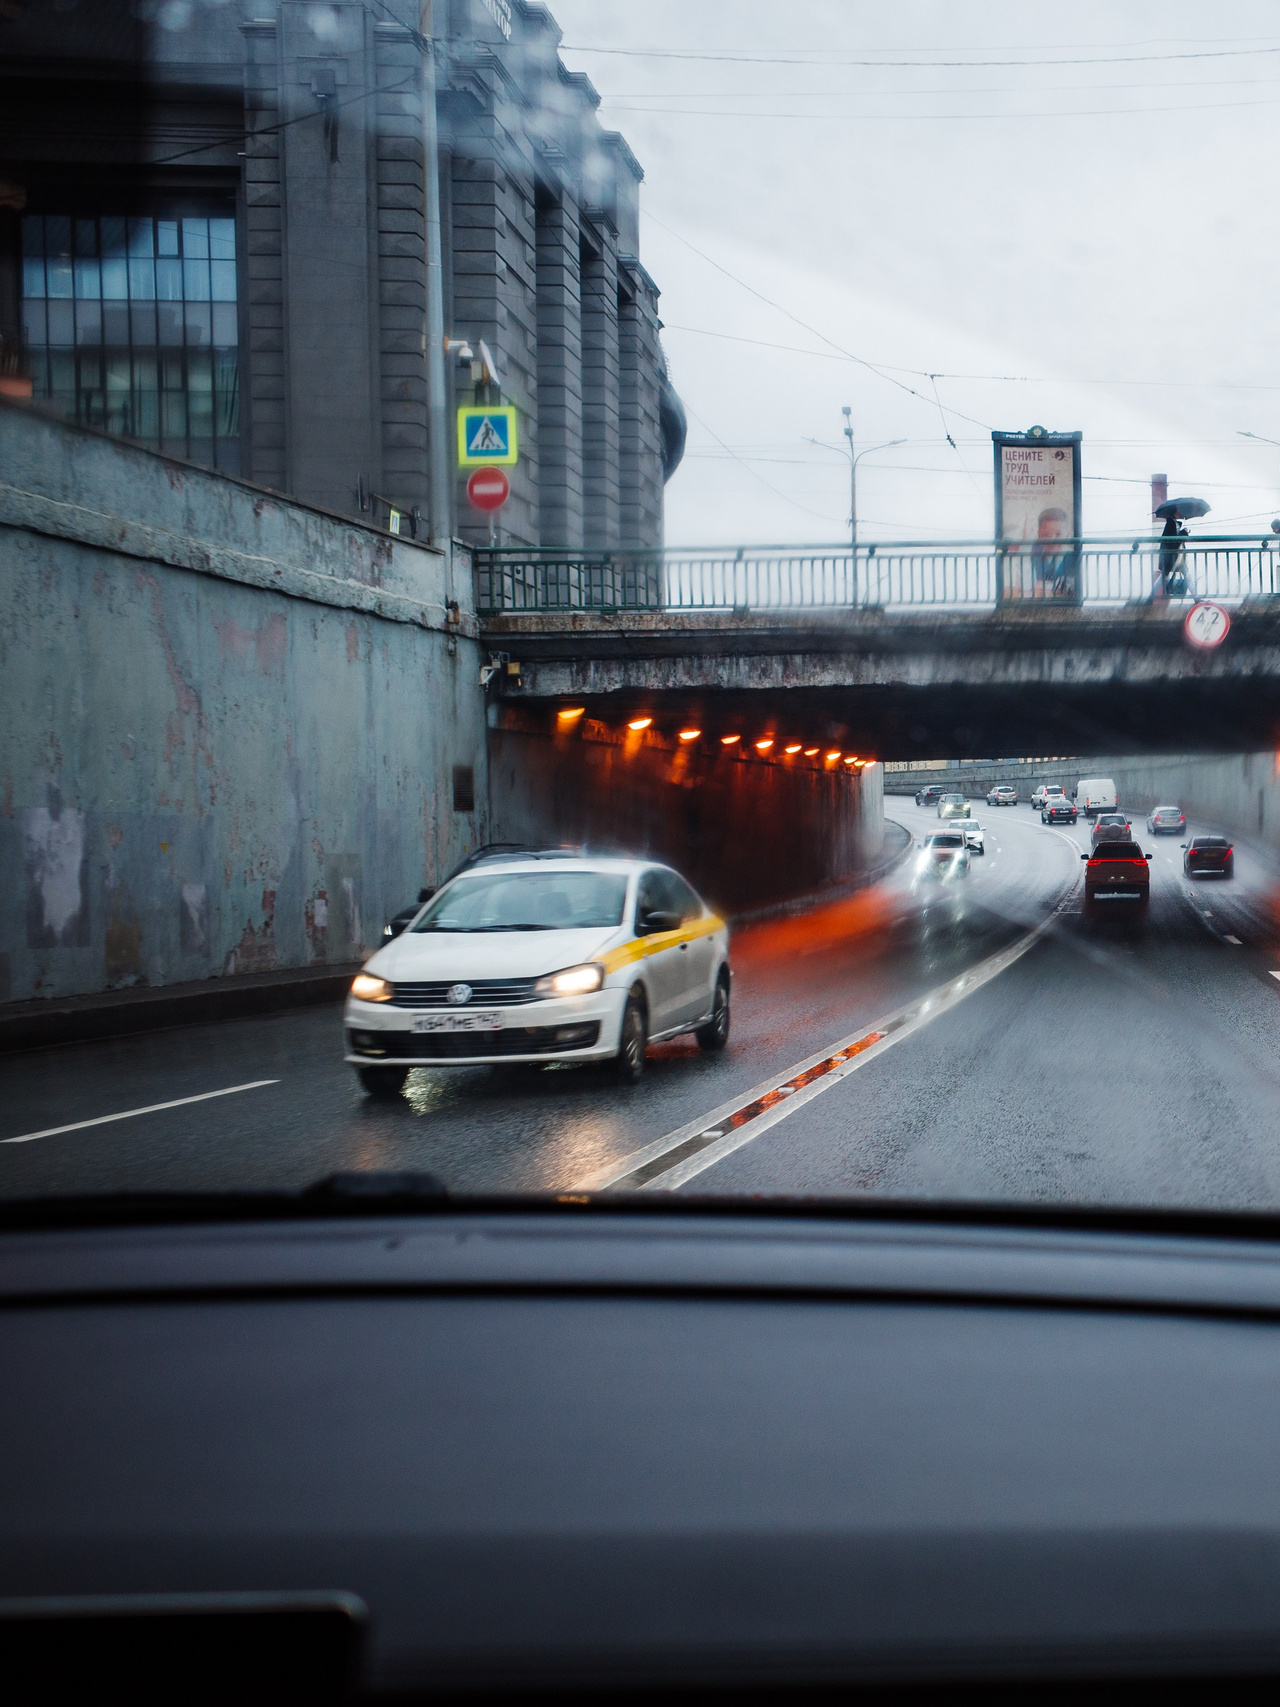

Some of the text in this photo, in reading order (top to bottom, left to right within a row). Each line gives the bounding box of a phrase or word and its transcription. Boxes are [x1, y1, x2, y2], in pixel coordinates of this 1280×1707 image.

[1005, 450, 1043, 461] ЦЕНИТЕ
[1005, 463, 1029, 474] ТРУД
[1005, 473, 1056, 486] УЧИТЕЛЕЙ
